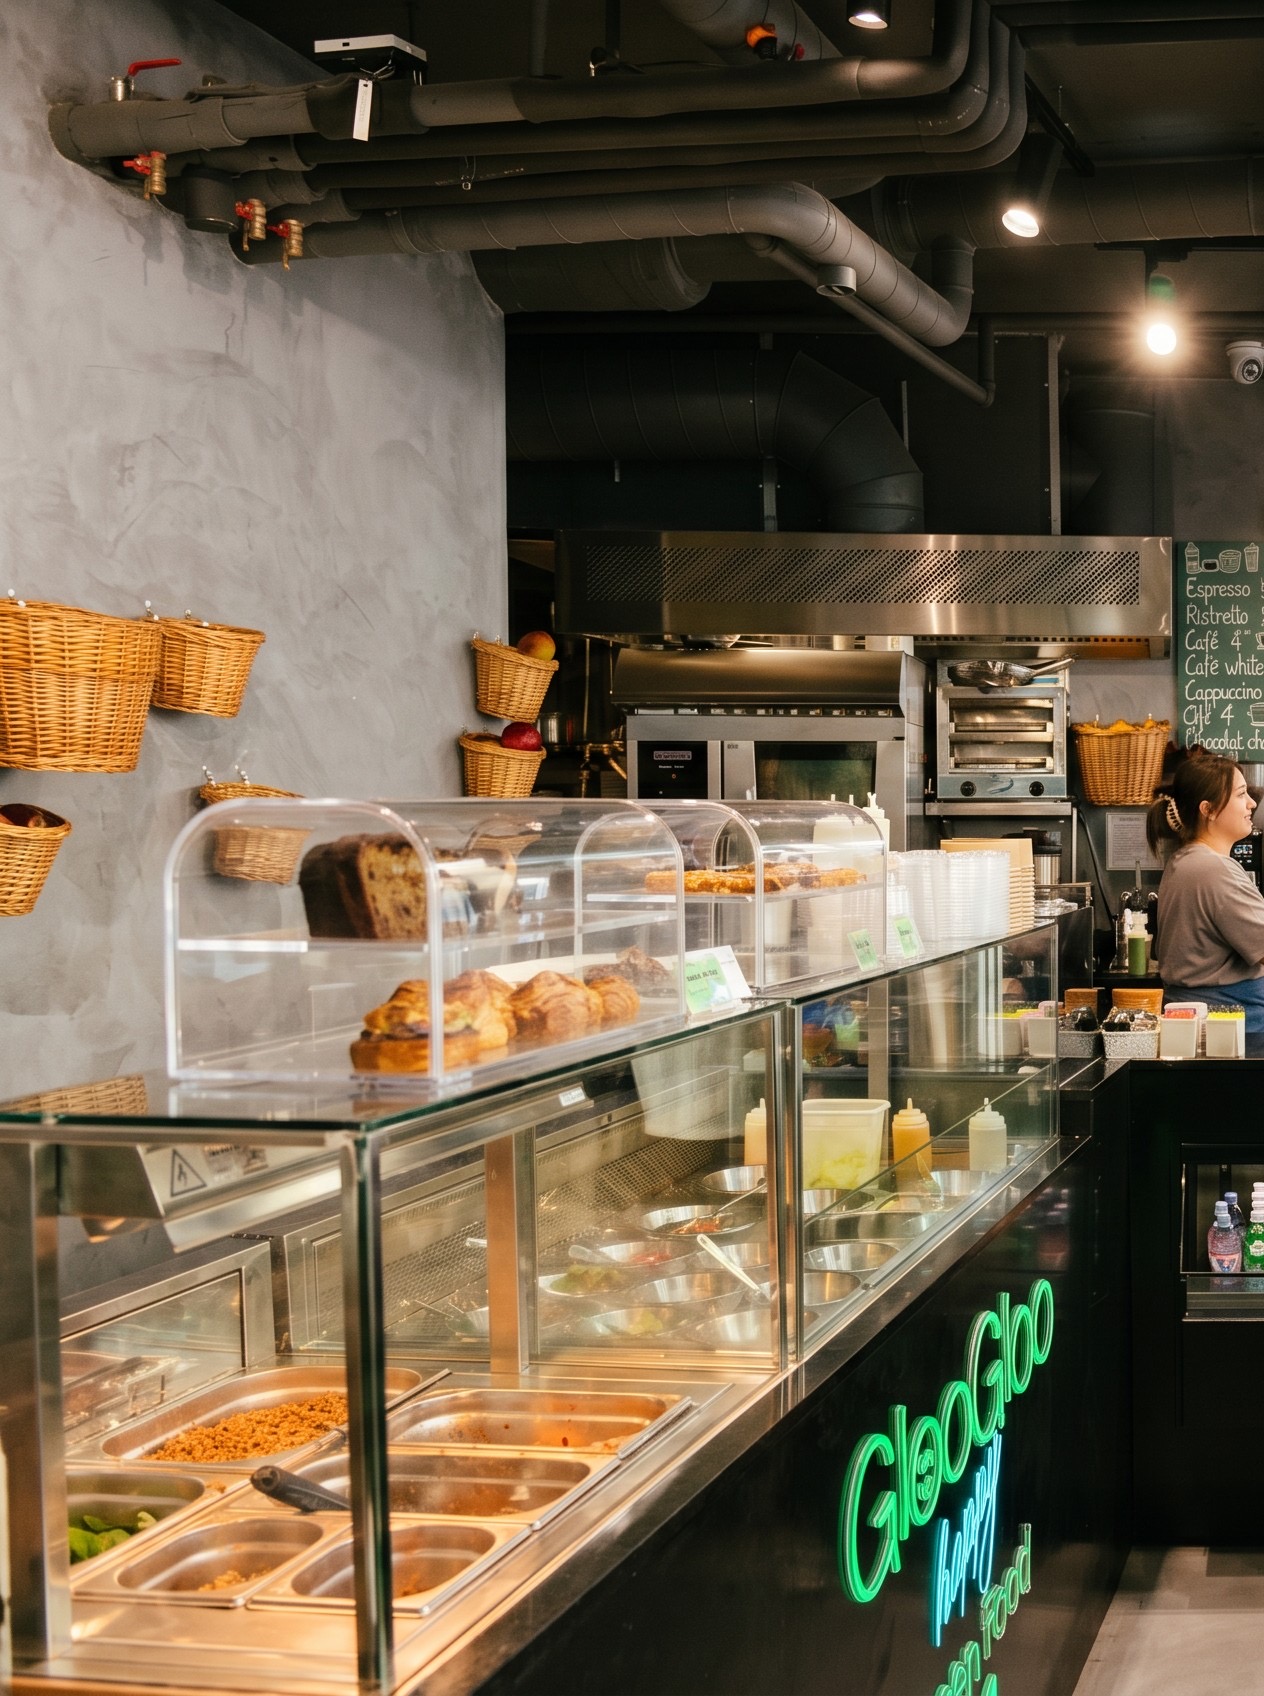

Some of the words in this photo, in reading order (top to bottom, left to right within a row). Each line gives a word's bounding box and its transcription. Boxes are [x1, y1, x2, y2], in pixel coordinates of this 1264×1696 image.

[1186, 577, 1251, 605] Espresso
[1186, 603, 1249, 625] Ristretto
[1185, 629, 1219, 654] Café
[1185, 654, 1219, 677] Café
[1225, 653, 1264, 675] white
[1185, 679, 1263, 708] Cappuccino
[935, 1641, 981, 1696] en
